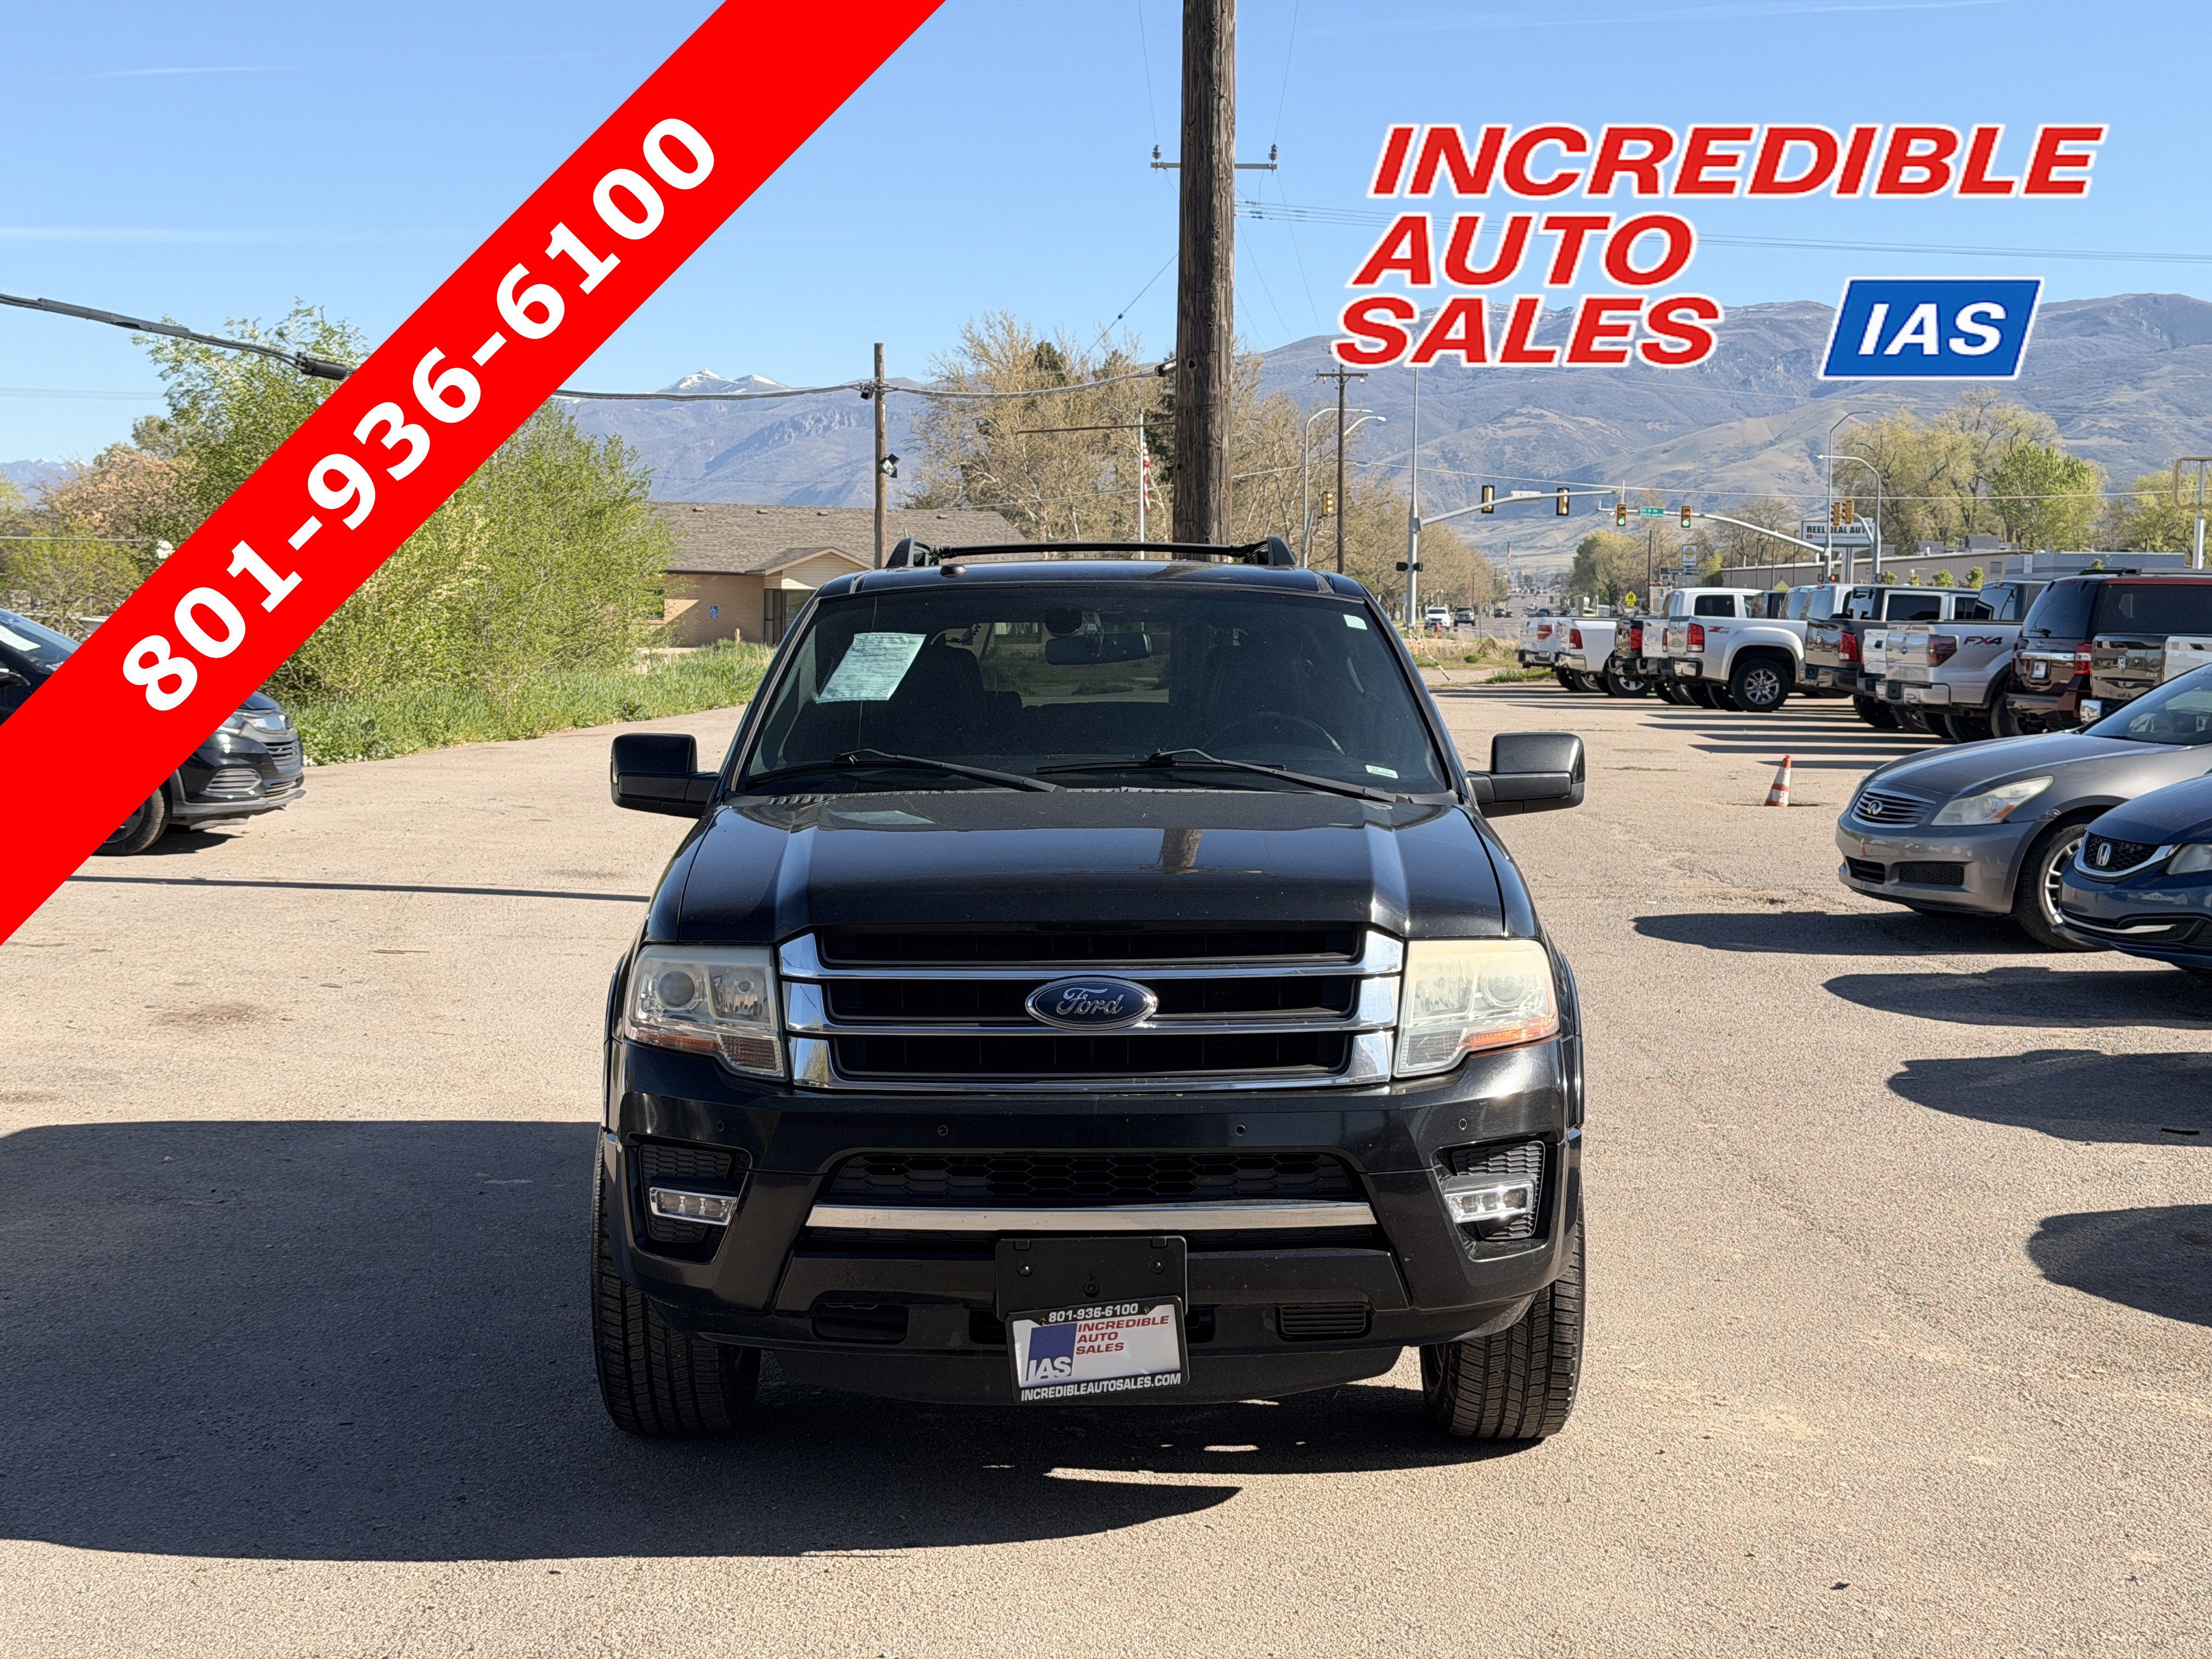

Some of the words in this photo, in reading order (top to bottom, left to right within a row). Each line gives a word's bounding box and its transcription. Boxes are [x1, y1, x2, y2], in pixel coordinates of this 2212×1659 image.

[1807, 526, 1826, 534] REEL
[1963, 636, 2004, 645] FX4
[1056, 987, 1125, 1015] Ford
[1048, 1303, 1138, 1322] 801-936-6100
[1078, 1315, 1170, 1333] INCREDIBLE
[1076, 1331, 1119, 1344] AUTO
[1075, 1342, 1125, 1355] SALES
[1028, 1356, 1071, 1380] IAS
[1020, 1373, 1181, 1402] INCREDIBLEAUTOSALES.COM
